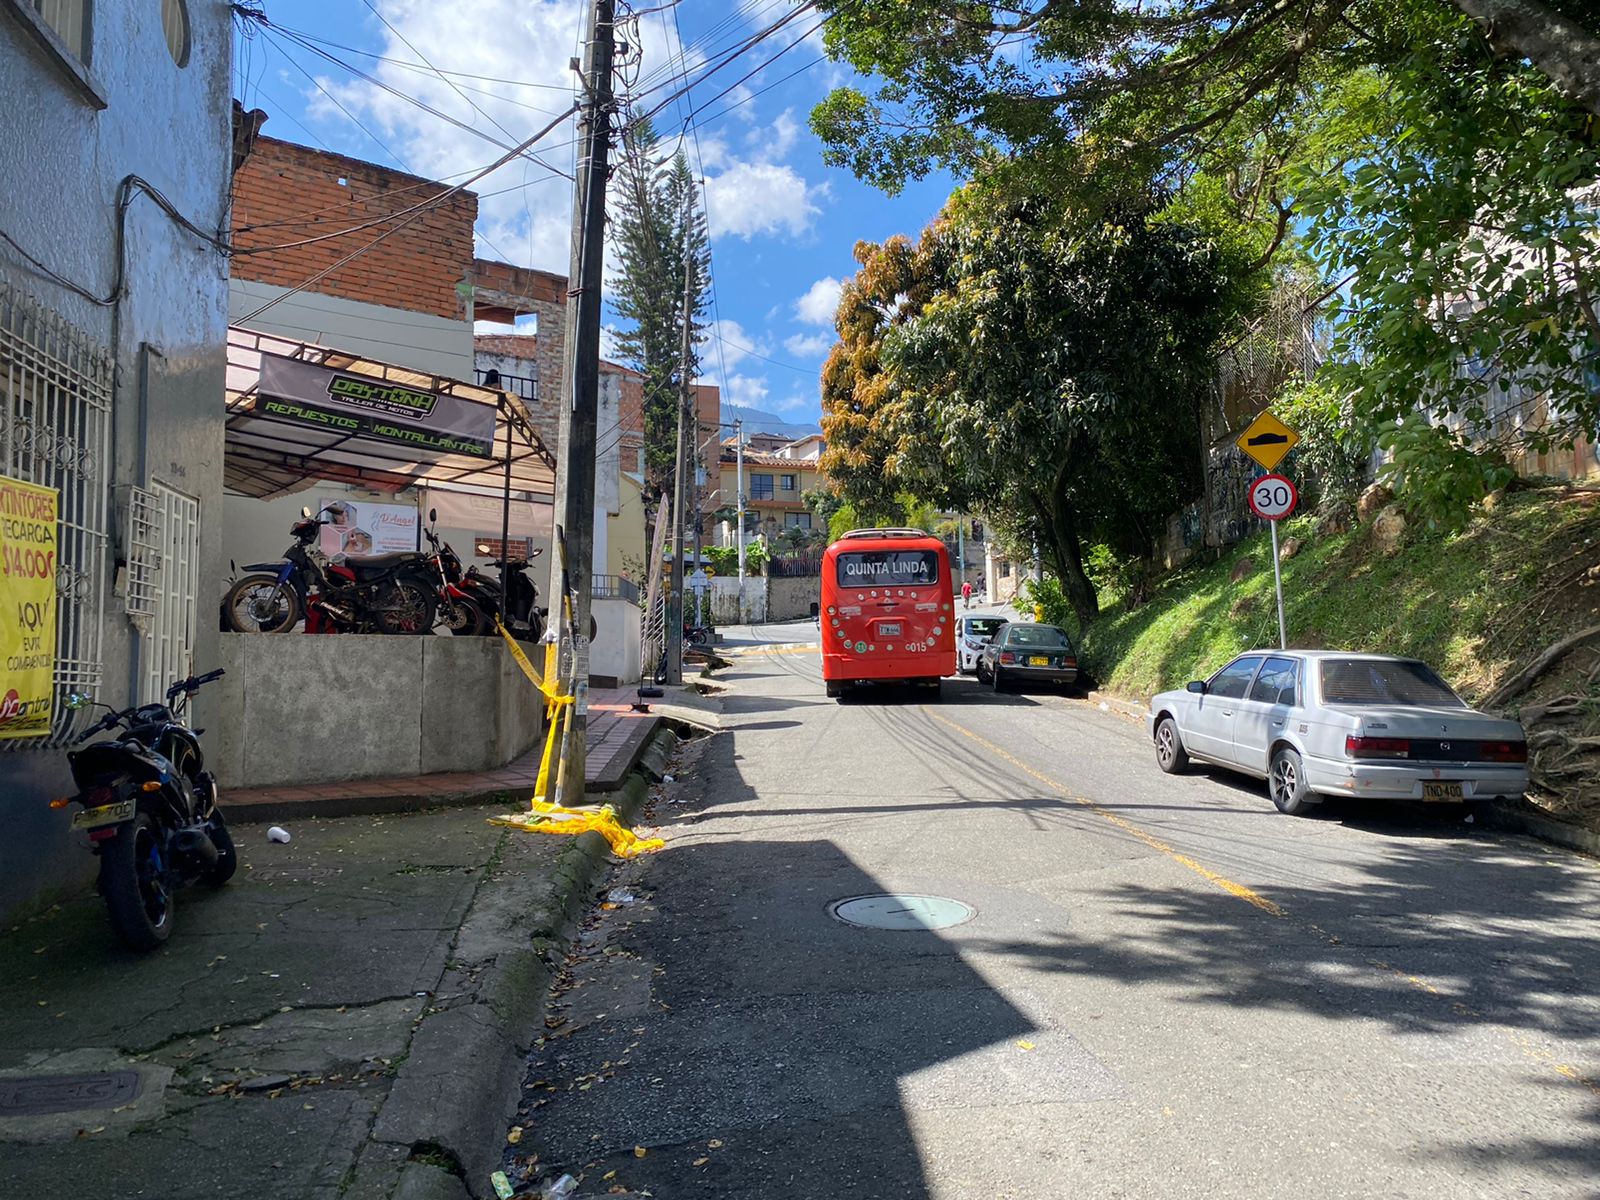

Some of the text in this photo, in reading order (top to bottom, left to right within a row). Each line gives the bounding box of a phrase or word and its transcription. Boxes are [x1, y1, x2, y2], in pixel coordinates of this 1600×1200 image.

[331, 378, 436, 409] DAYTONA
[341, 395, 415, 416] TALLER DE MOTOS
[265, 402, 359, 429] REPUESTOS
[373, 423, 483, 454] MONTALLANTAS
[1257, 486, 1289, 507] 30
[846, 561, 928, 575] QUINTA LINDA
